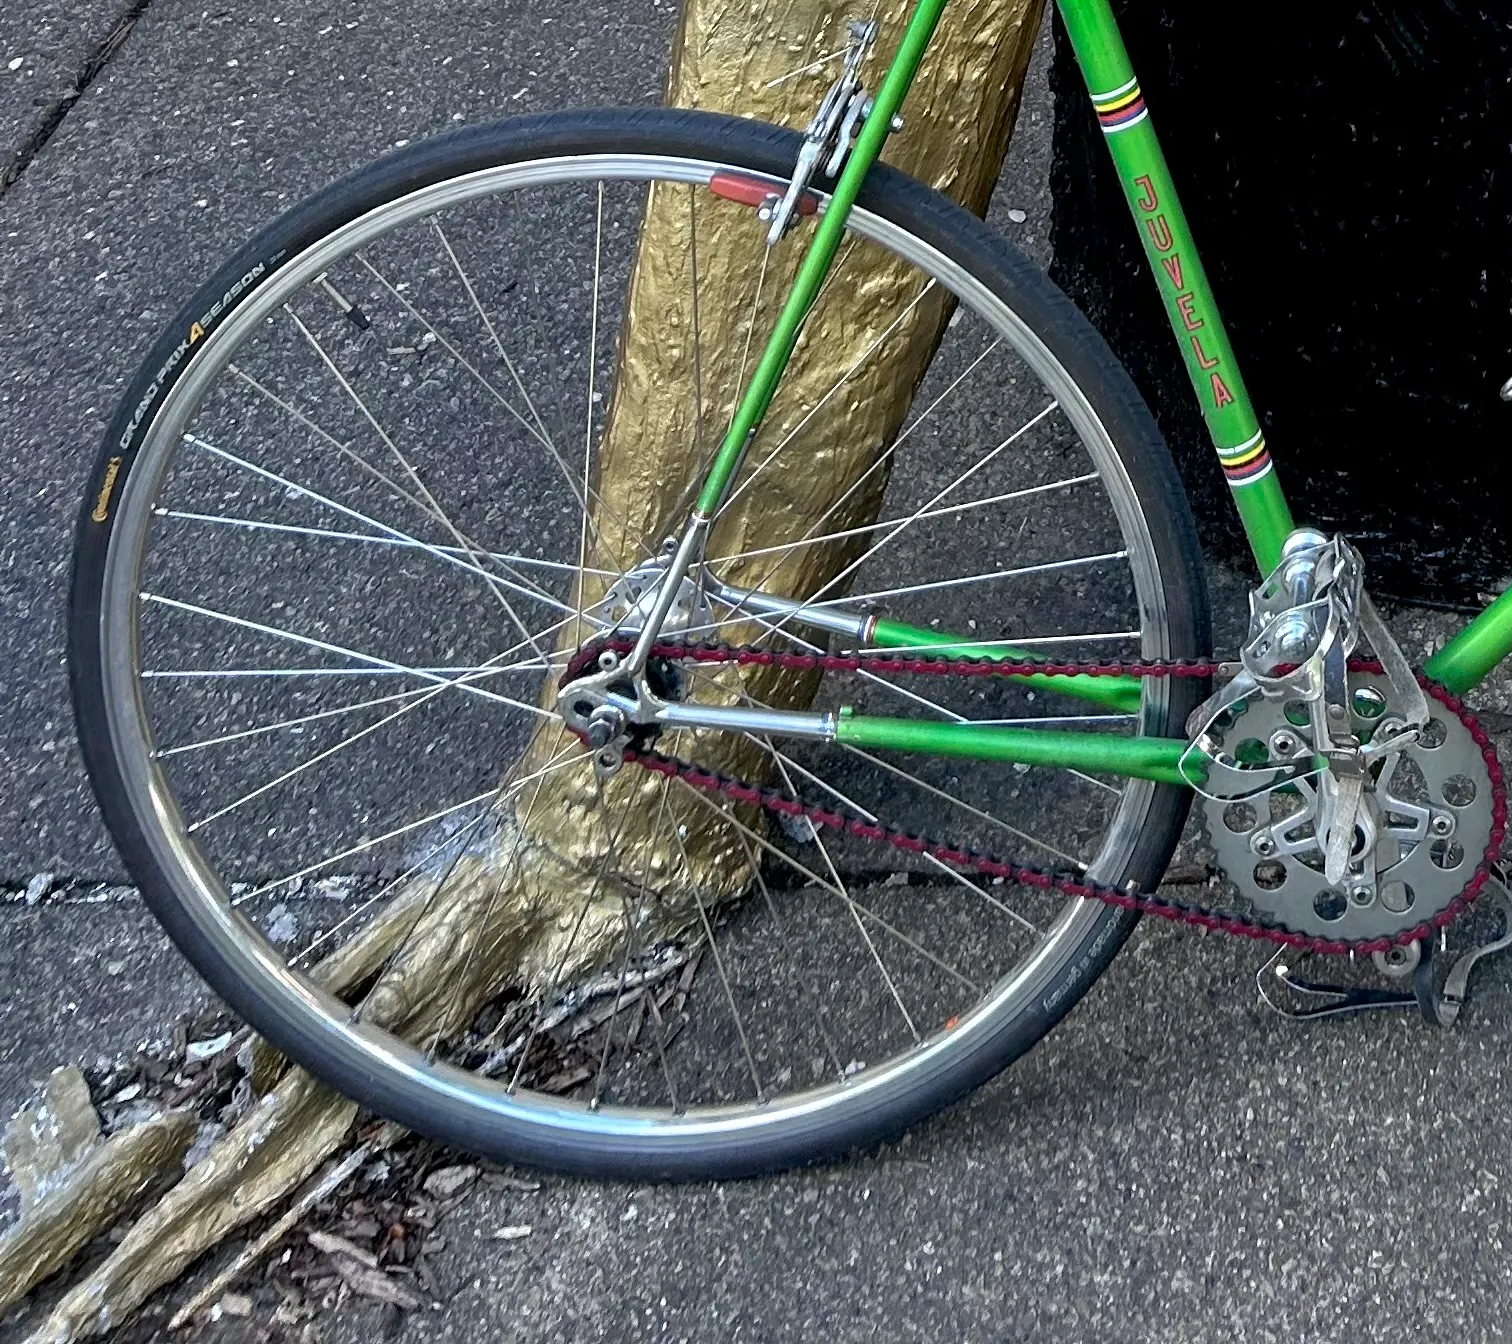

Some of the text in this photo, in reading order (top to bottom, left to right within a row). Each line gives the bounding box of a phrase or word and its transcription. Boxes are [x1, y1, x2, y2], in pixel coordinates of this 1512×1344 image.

[119, 380, 159, 450] GRAND
[156, 339, 191, 385] PRIX
[200, 261, 267, 328] SEASON
[1134, 174, 1233, 408] JUVELA
[1089, 904, 1125, 957] andmade
